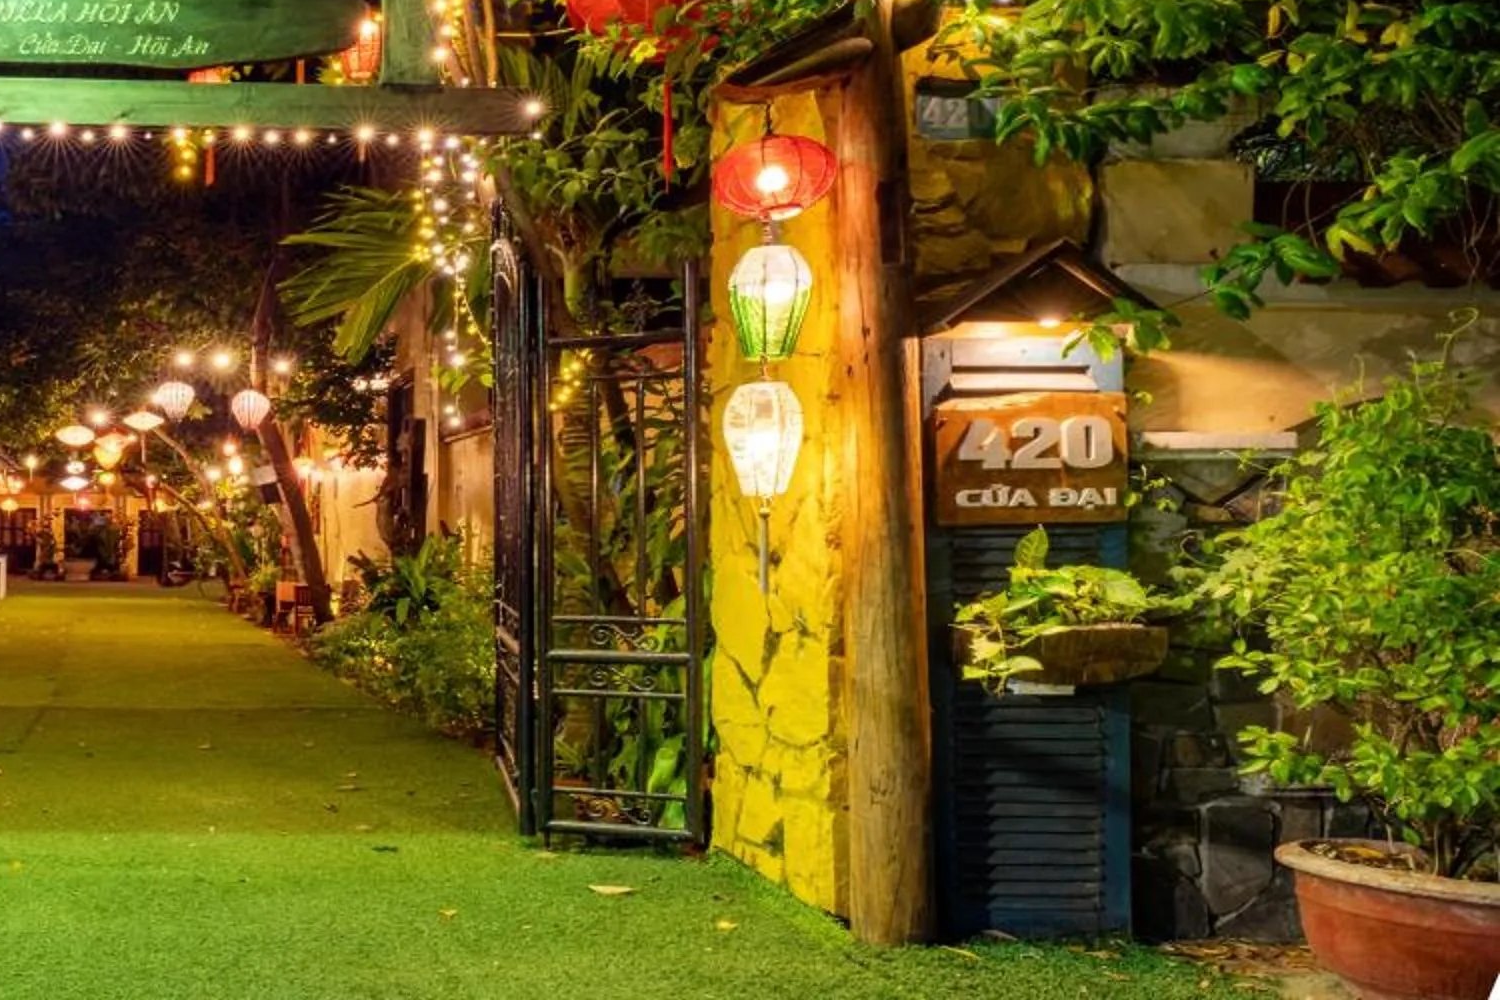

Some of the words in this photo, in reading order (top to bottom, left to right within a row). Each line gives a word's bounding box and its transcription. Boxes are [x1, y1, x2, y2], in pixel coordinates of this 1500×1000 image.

[134, 2, 179, 24] AN
[172, 34, 210, 57] An
[958, 415, 1114, 470] 420
[1049, 487, 1117, 510] ĐẠI
